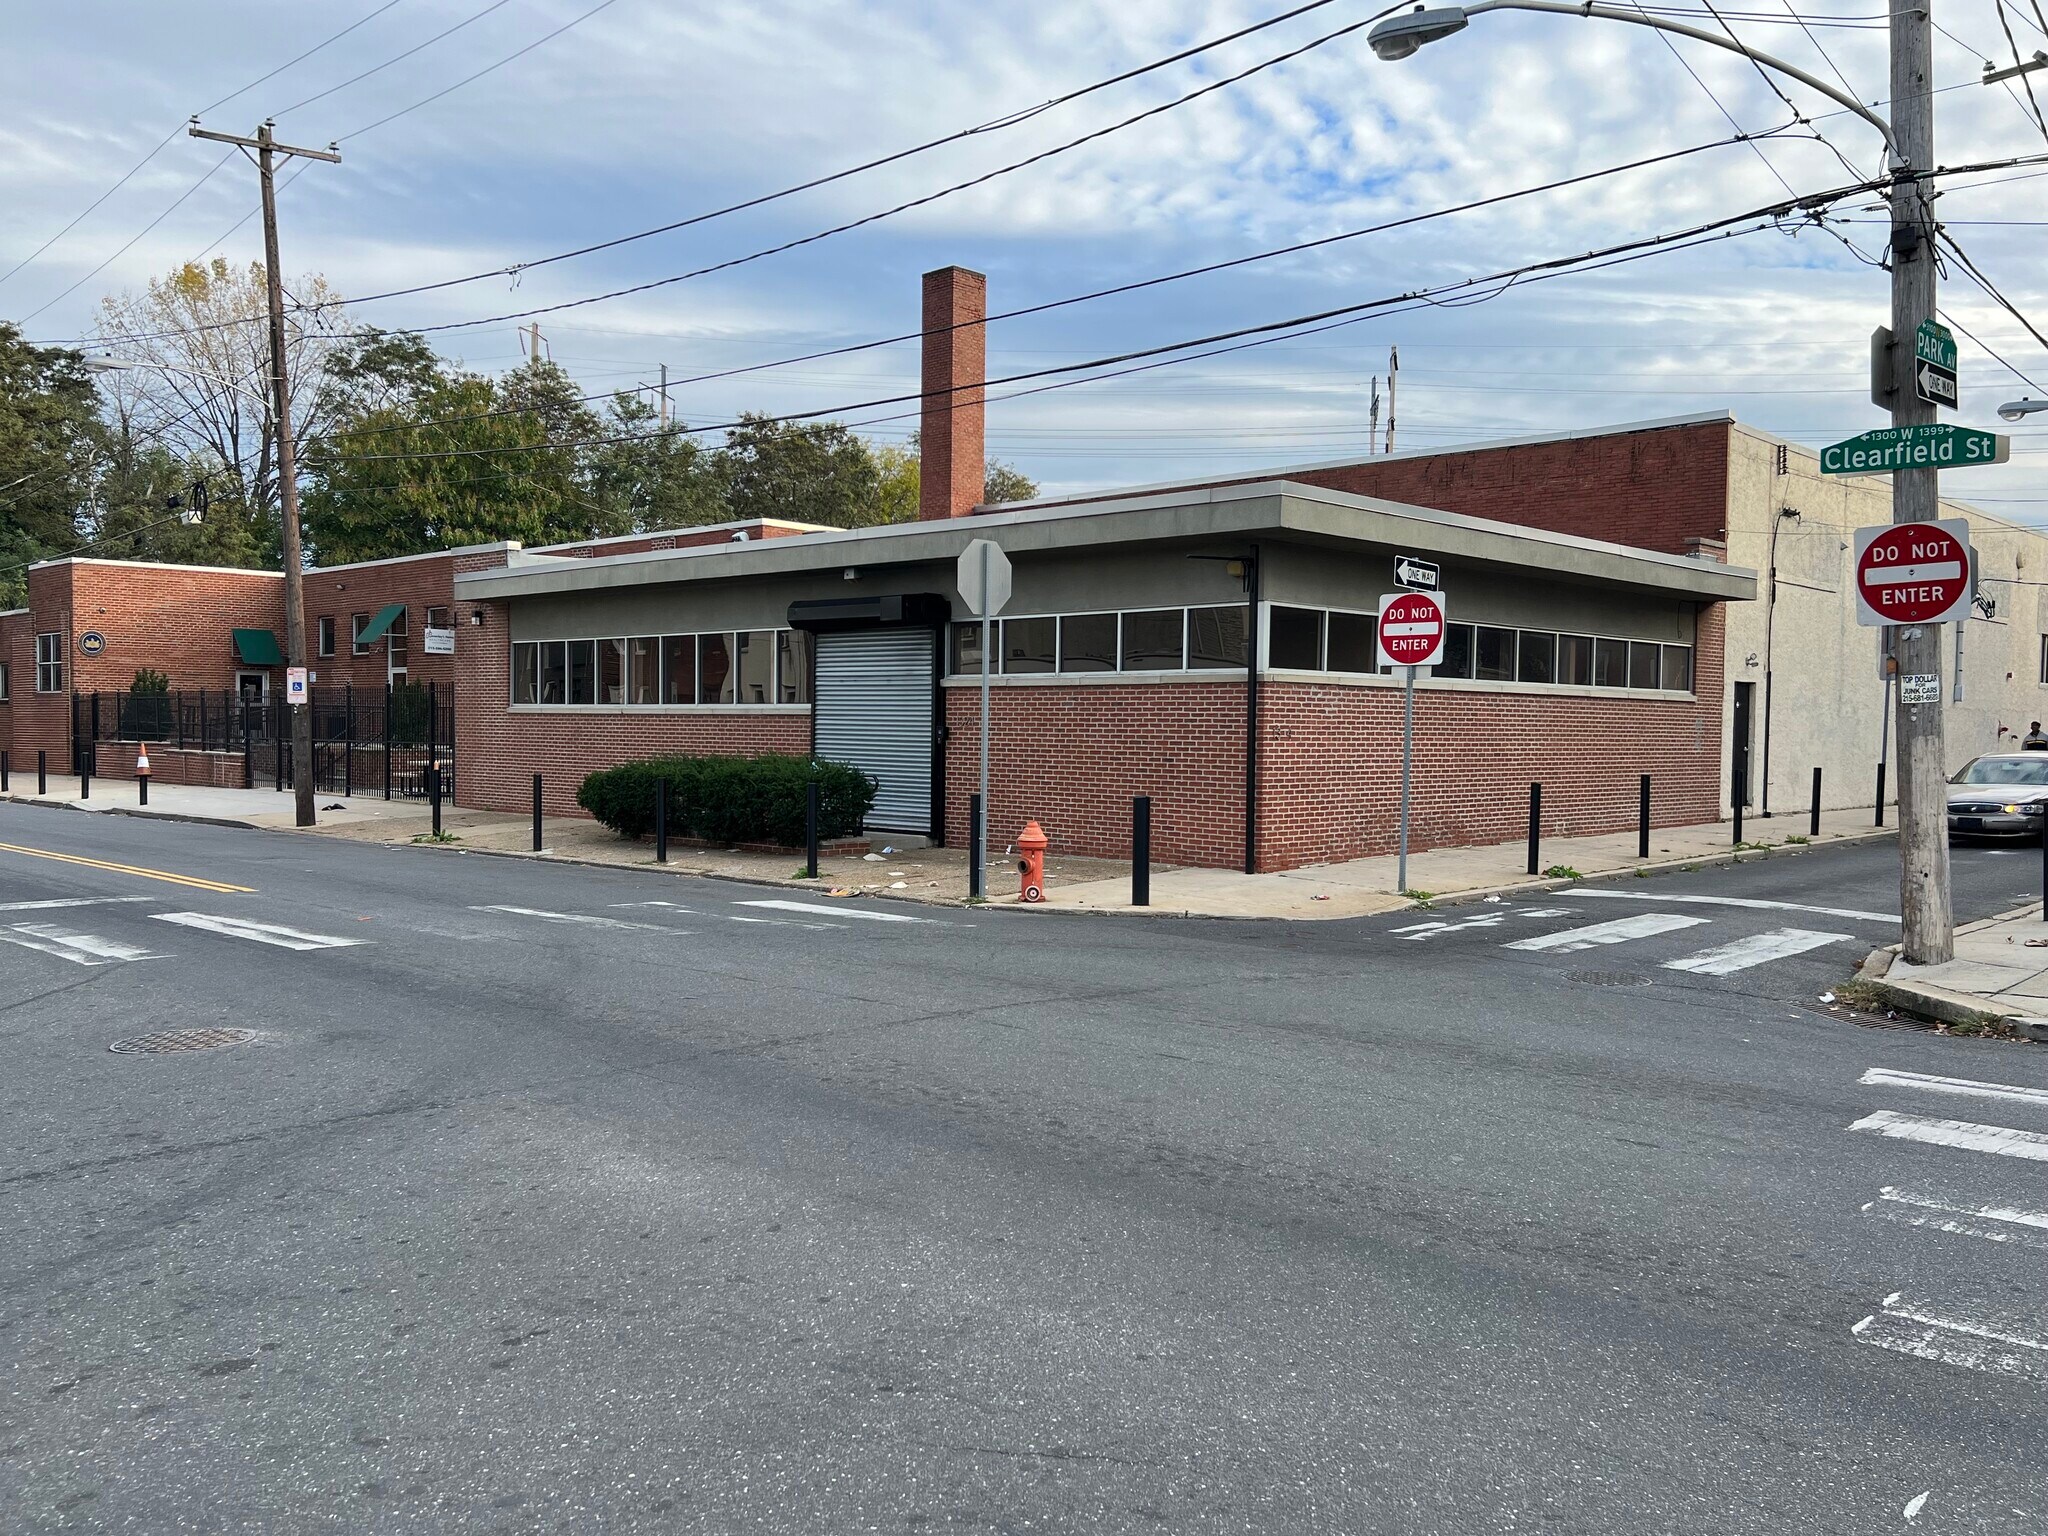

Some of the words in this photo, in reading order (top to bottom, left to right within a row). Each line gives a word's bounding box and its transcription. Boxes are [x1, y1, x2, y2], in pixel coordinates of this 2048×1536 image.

[1917, 331, 1944, 364] PARK
[1947, 352, 1956, 369] AV
[1929, 374, 1940, 392] ONE
[1941, 379, 1953, 397] WAY
[1871, 430, 1897, 441] 1300
[1901, 428, 1914, 440] W
[1919, 426, 1944, 437] 1399
[1825, 438, 1953, 470] Clearfield
[1965, 437, 1991, 458] St
[1872, 545, 1899, 563] DO
[1911, 541, 1950, 559] NOT
[1407, 567, 1420, 580] ONE
[1421, 570, 1435, 583] WAY
[1882, 586, 1944, 605] ENTER
[1389, 608, 1405, 620] DO
[1411, 607, 1434, 619] NOT
[1392, 639, 1428, 651] ENTER
[1902, 676, 1913, 684] TOP
[1914, 674, 1938, 683] DOLLAR
[1903, 687, 1921, 695] JUNK
[1921, 686, 1938, 694] CARS
